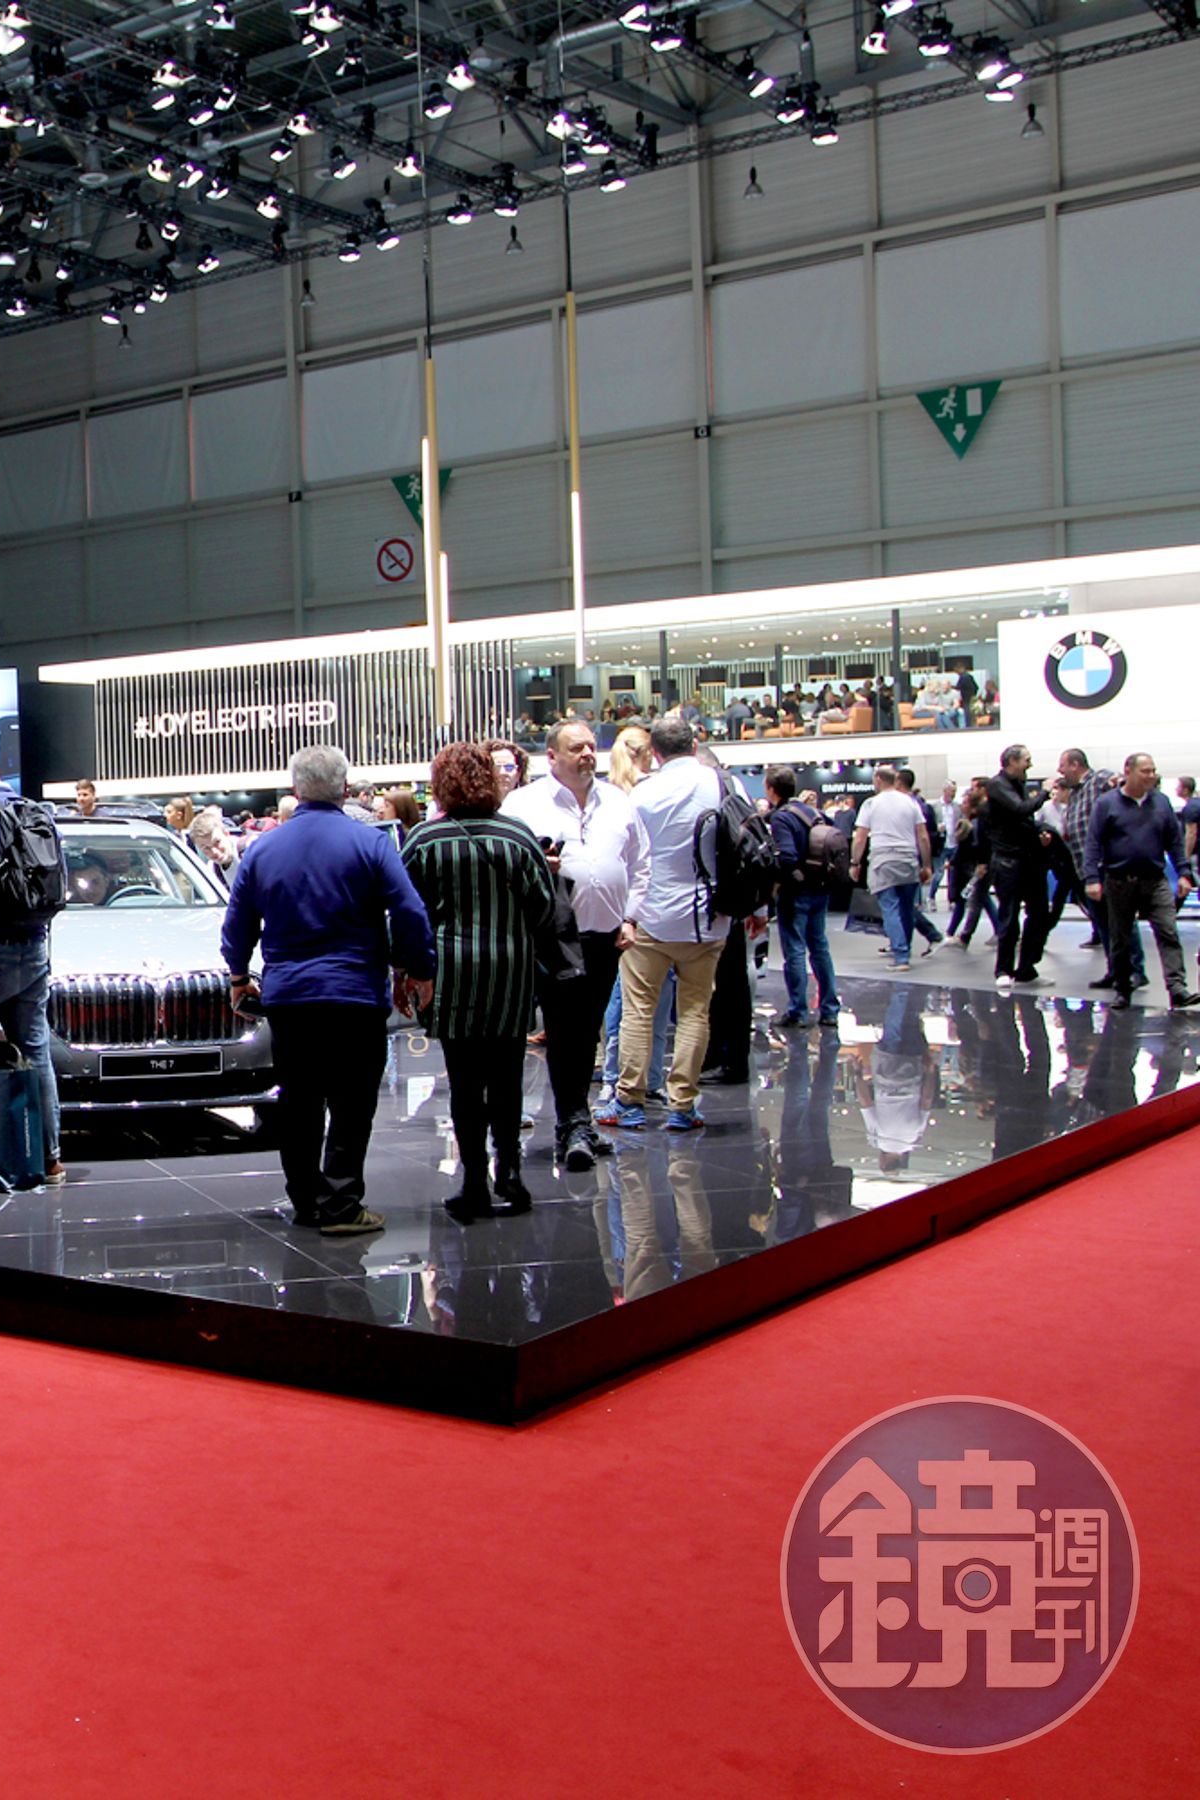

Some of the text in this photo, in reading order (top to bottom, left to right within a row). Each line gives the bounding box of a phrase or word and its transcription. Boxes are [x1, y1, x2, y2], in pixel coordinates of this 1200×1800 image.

[1049, 630, 1122, 660] BMW
[134, 700, 337, 738] #JOY ELECTRIFIED
[821, 783, 845, 793] BMW
[150, 1059, 167, 1069] THE
